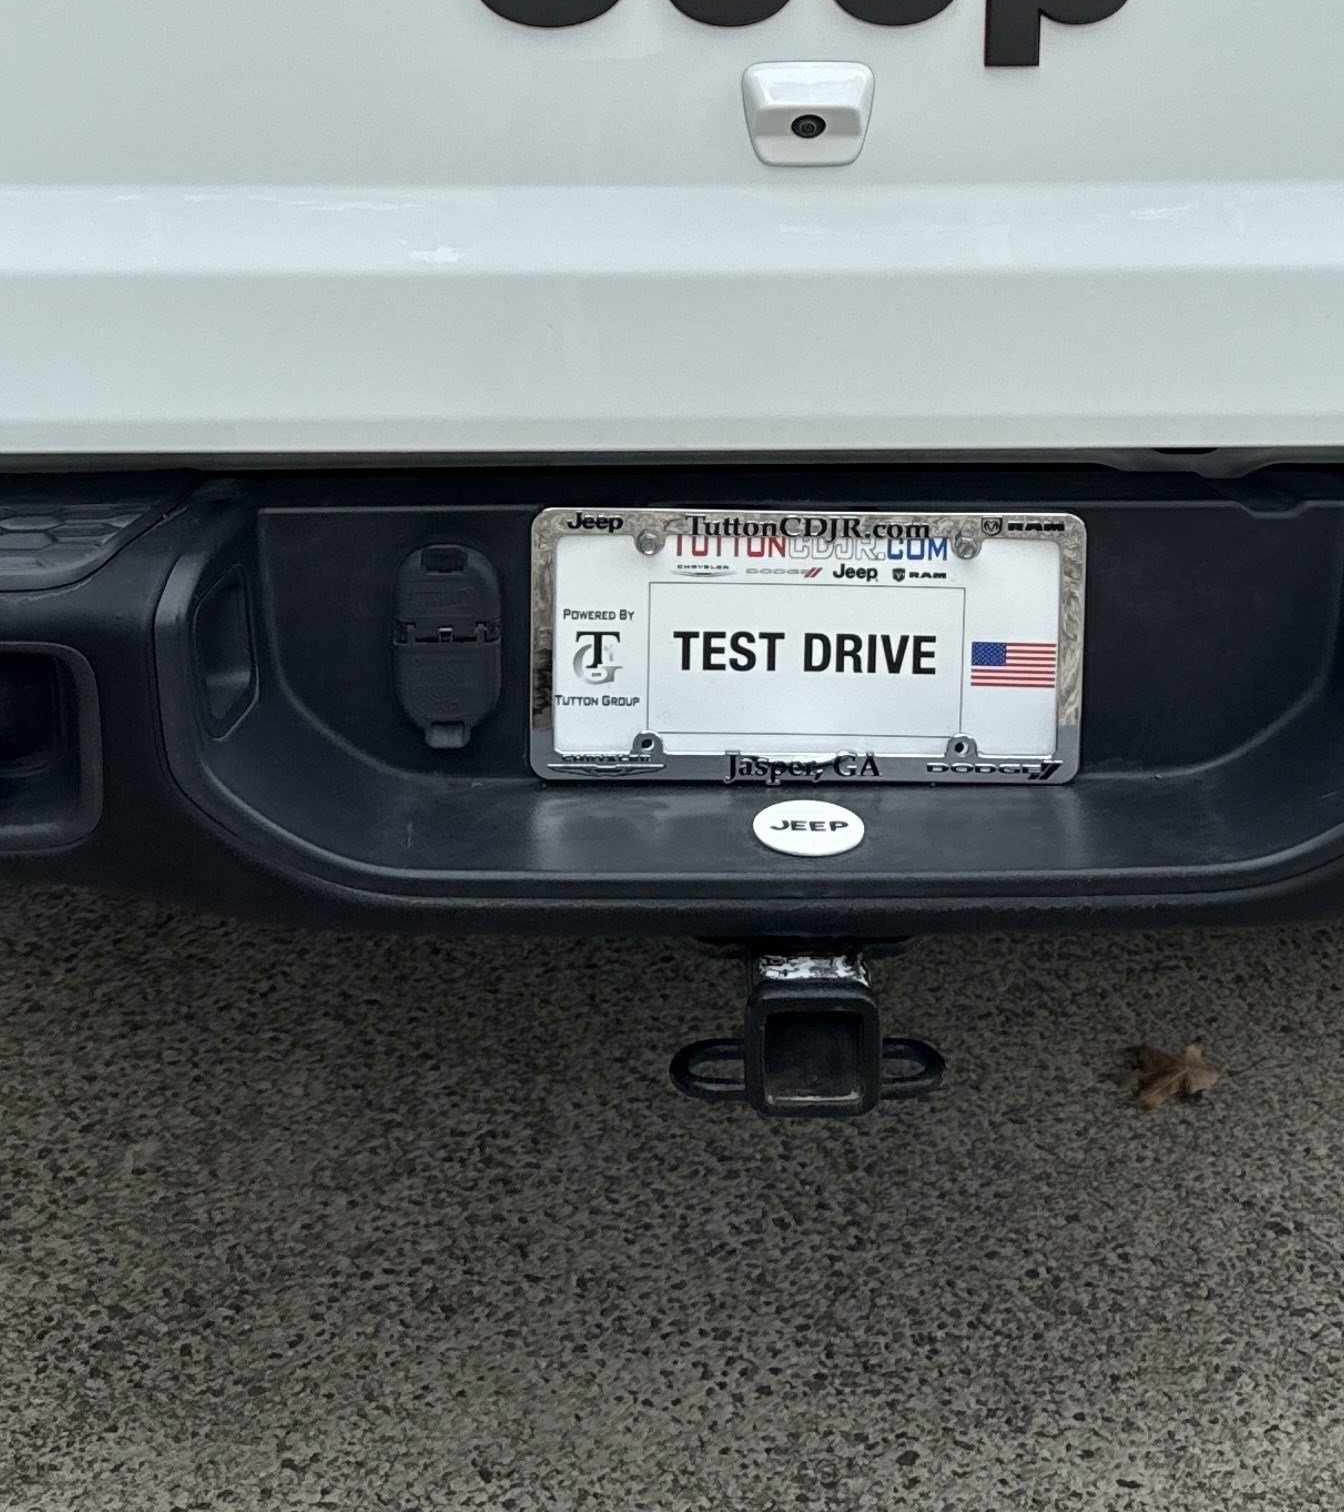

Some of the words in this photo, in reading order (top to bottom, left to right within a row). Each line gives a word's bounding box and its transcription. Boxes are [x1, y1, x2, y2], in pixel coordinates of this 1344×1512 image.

[566, 511, 624, 534] Jeep
[684, 513, 930, 544] TuttonCDJR.com
[1007, 521, 1066, 532] RAM
[676, 533, 948, 561] TUTTONCDJR.COM
[832, 563, 879, 582] Jeep
[908, 572, 947, 580] RAM
[673, 630, 785, 672] TEST
[803, 632, 937, 675] DRIVE
[723, 750, 824, 786] Jasper,
[832, 751, 884, 778] GA
[925, 761, 1044, 775] DODGE
[770, 819, 849, 832] JEEP
